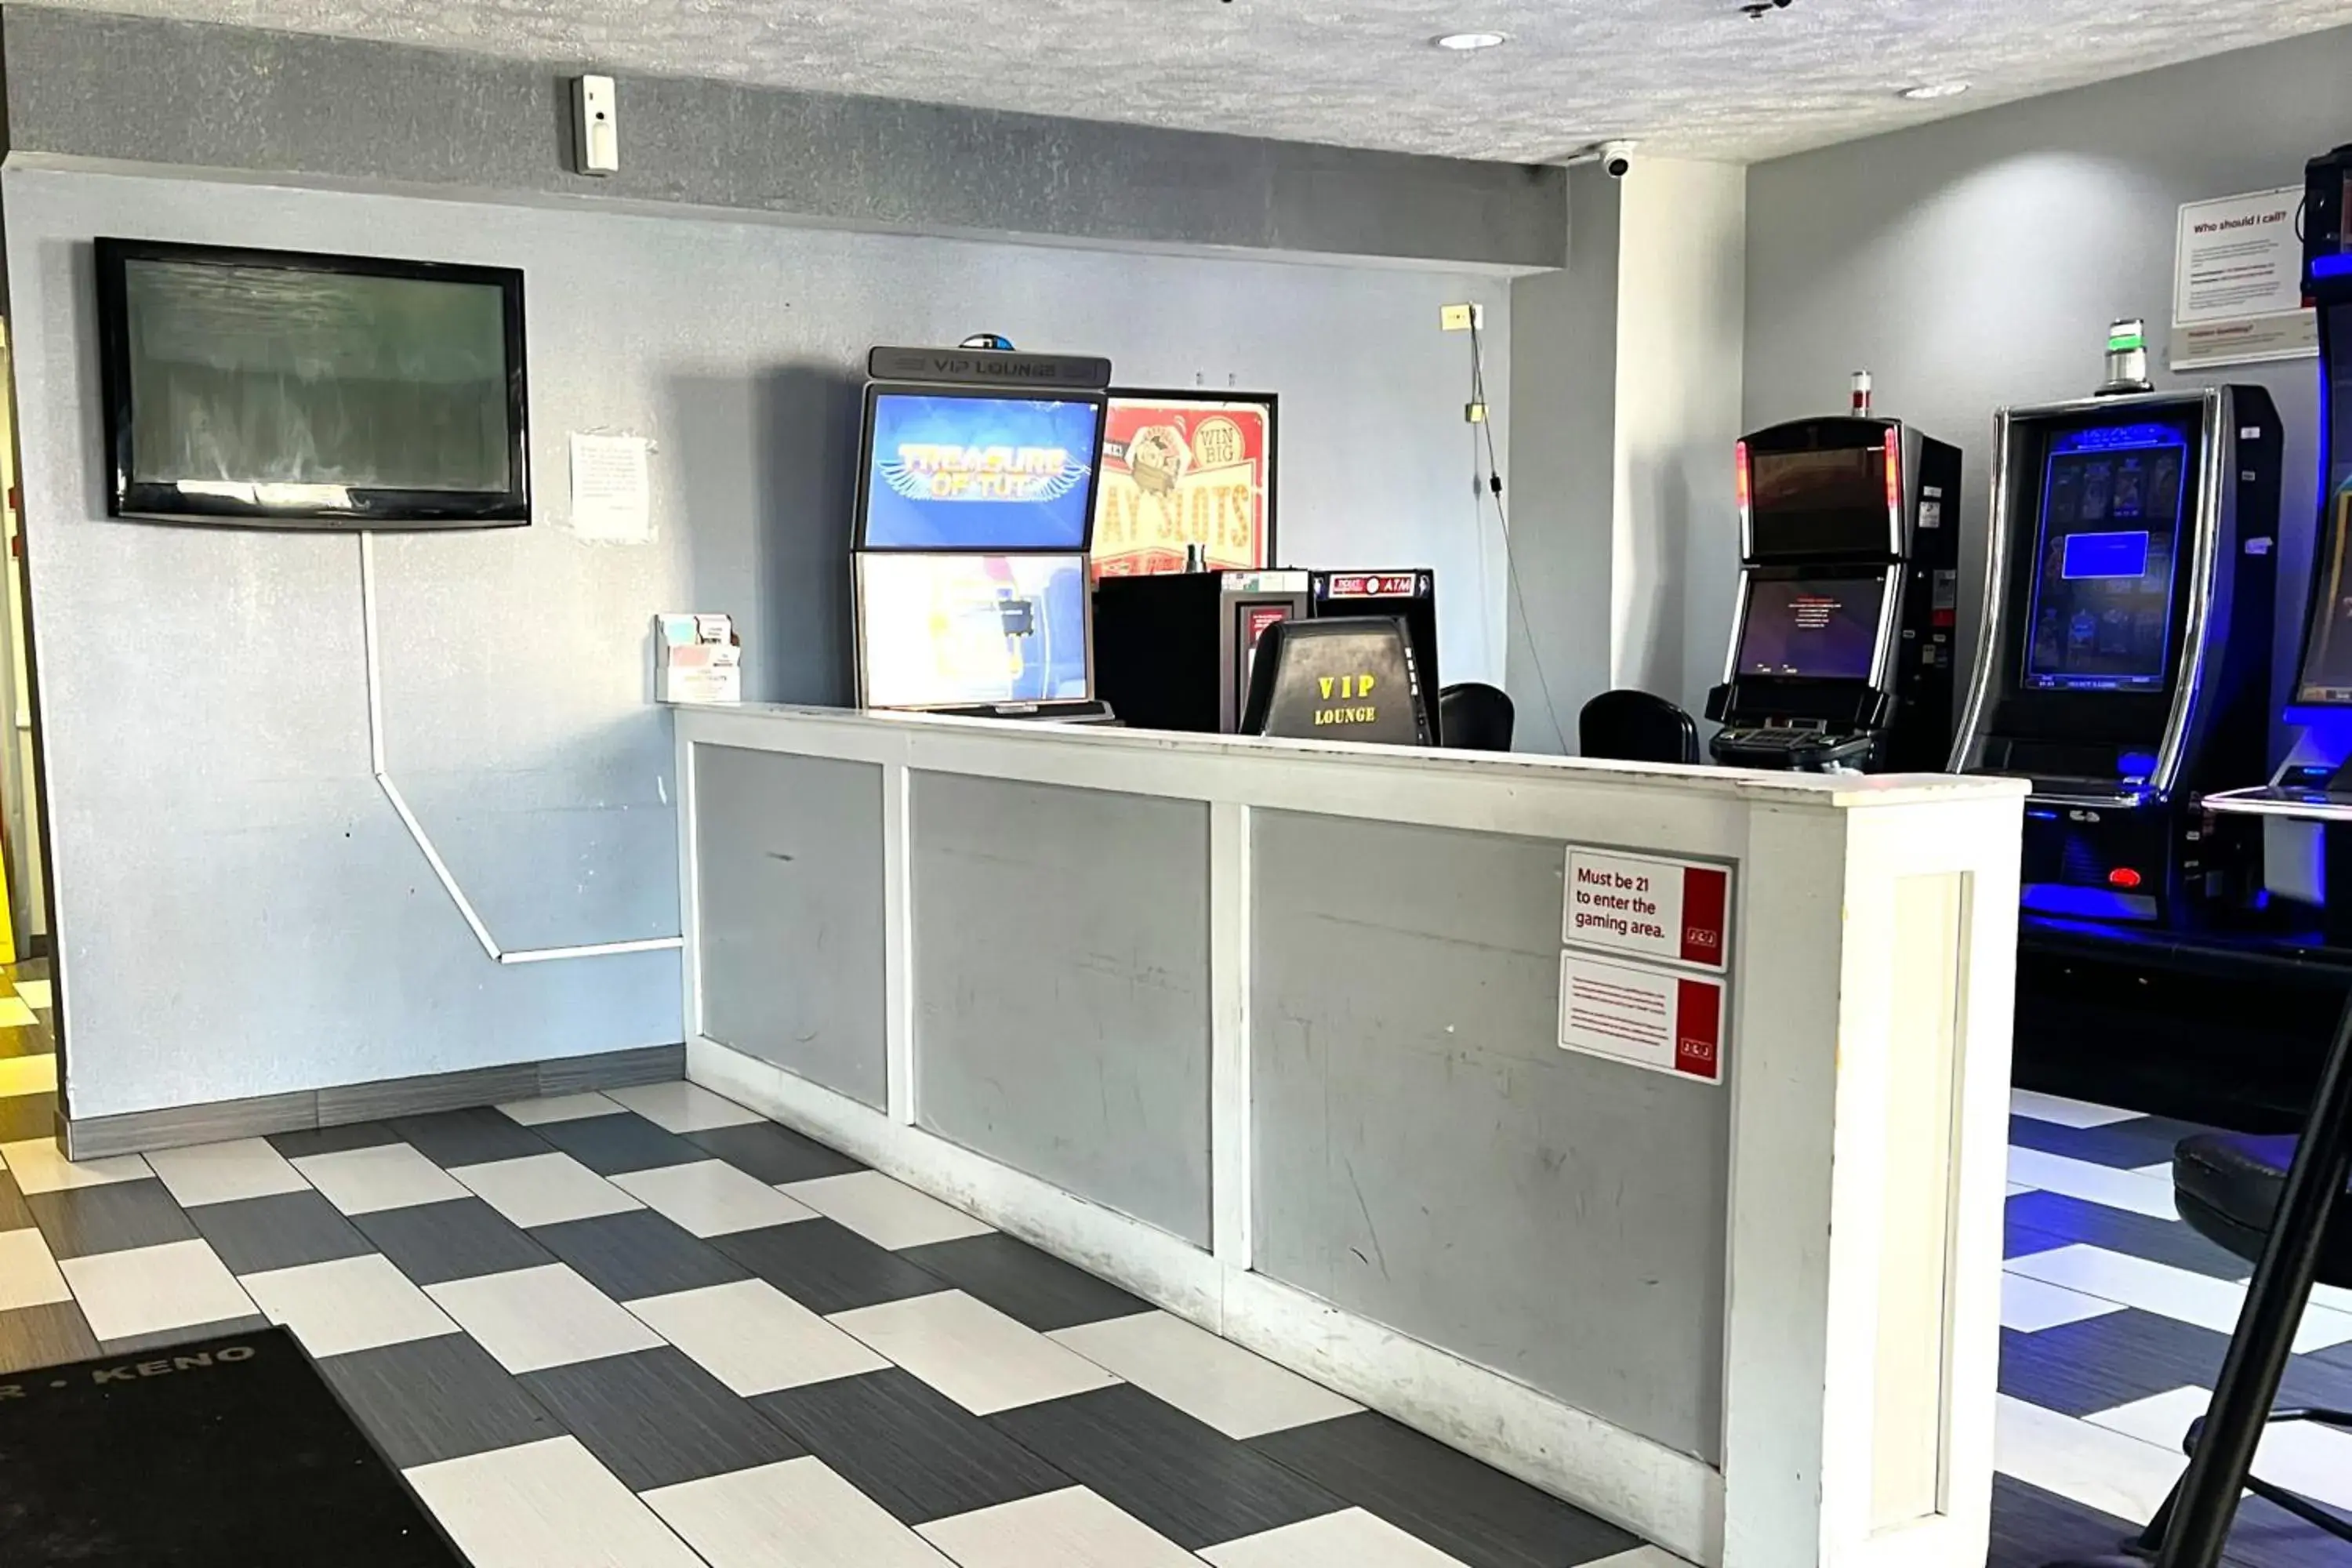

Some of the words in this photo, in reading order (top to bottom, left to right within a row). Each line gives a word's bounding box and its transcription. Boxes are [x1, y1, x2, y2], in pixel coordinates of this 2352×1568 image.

[2194, 223, 2216, 234] Who
[2220, 216, 2254, 230] should
[2262, 210, 2287, 224] call?
[934, 359, 970, 374] VIP
[1200, 427, 1234, 446] WIN
[1205, 446, 1234, 464] BIG
[931, 472, 970, 498] OF
[980, 473, 1027, 498] TUT
[1156, 483, 1250, 547] SLOTS
[1384, 577, 1411, 592] ATM
[1317, 673, 1375, 700] VIP
[1314, 706, 1375, 726] LOUNGE
[1577, 867, 1612, 887] Must
[1614, 872, 1633, 890] be
[1636, 877, 1649, 892] 21
[1577, 890, 1591, 904] to
[1593, 893, 1630, 911] enter
[1633, 897, 1657, 915] the
[1575, 912, 1628, 935] gaming
[1630, 923, 1665, 938] area.
[91, 1346, 256, 1385] KENO
